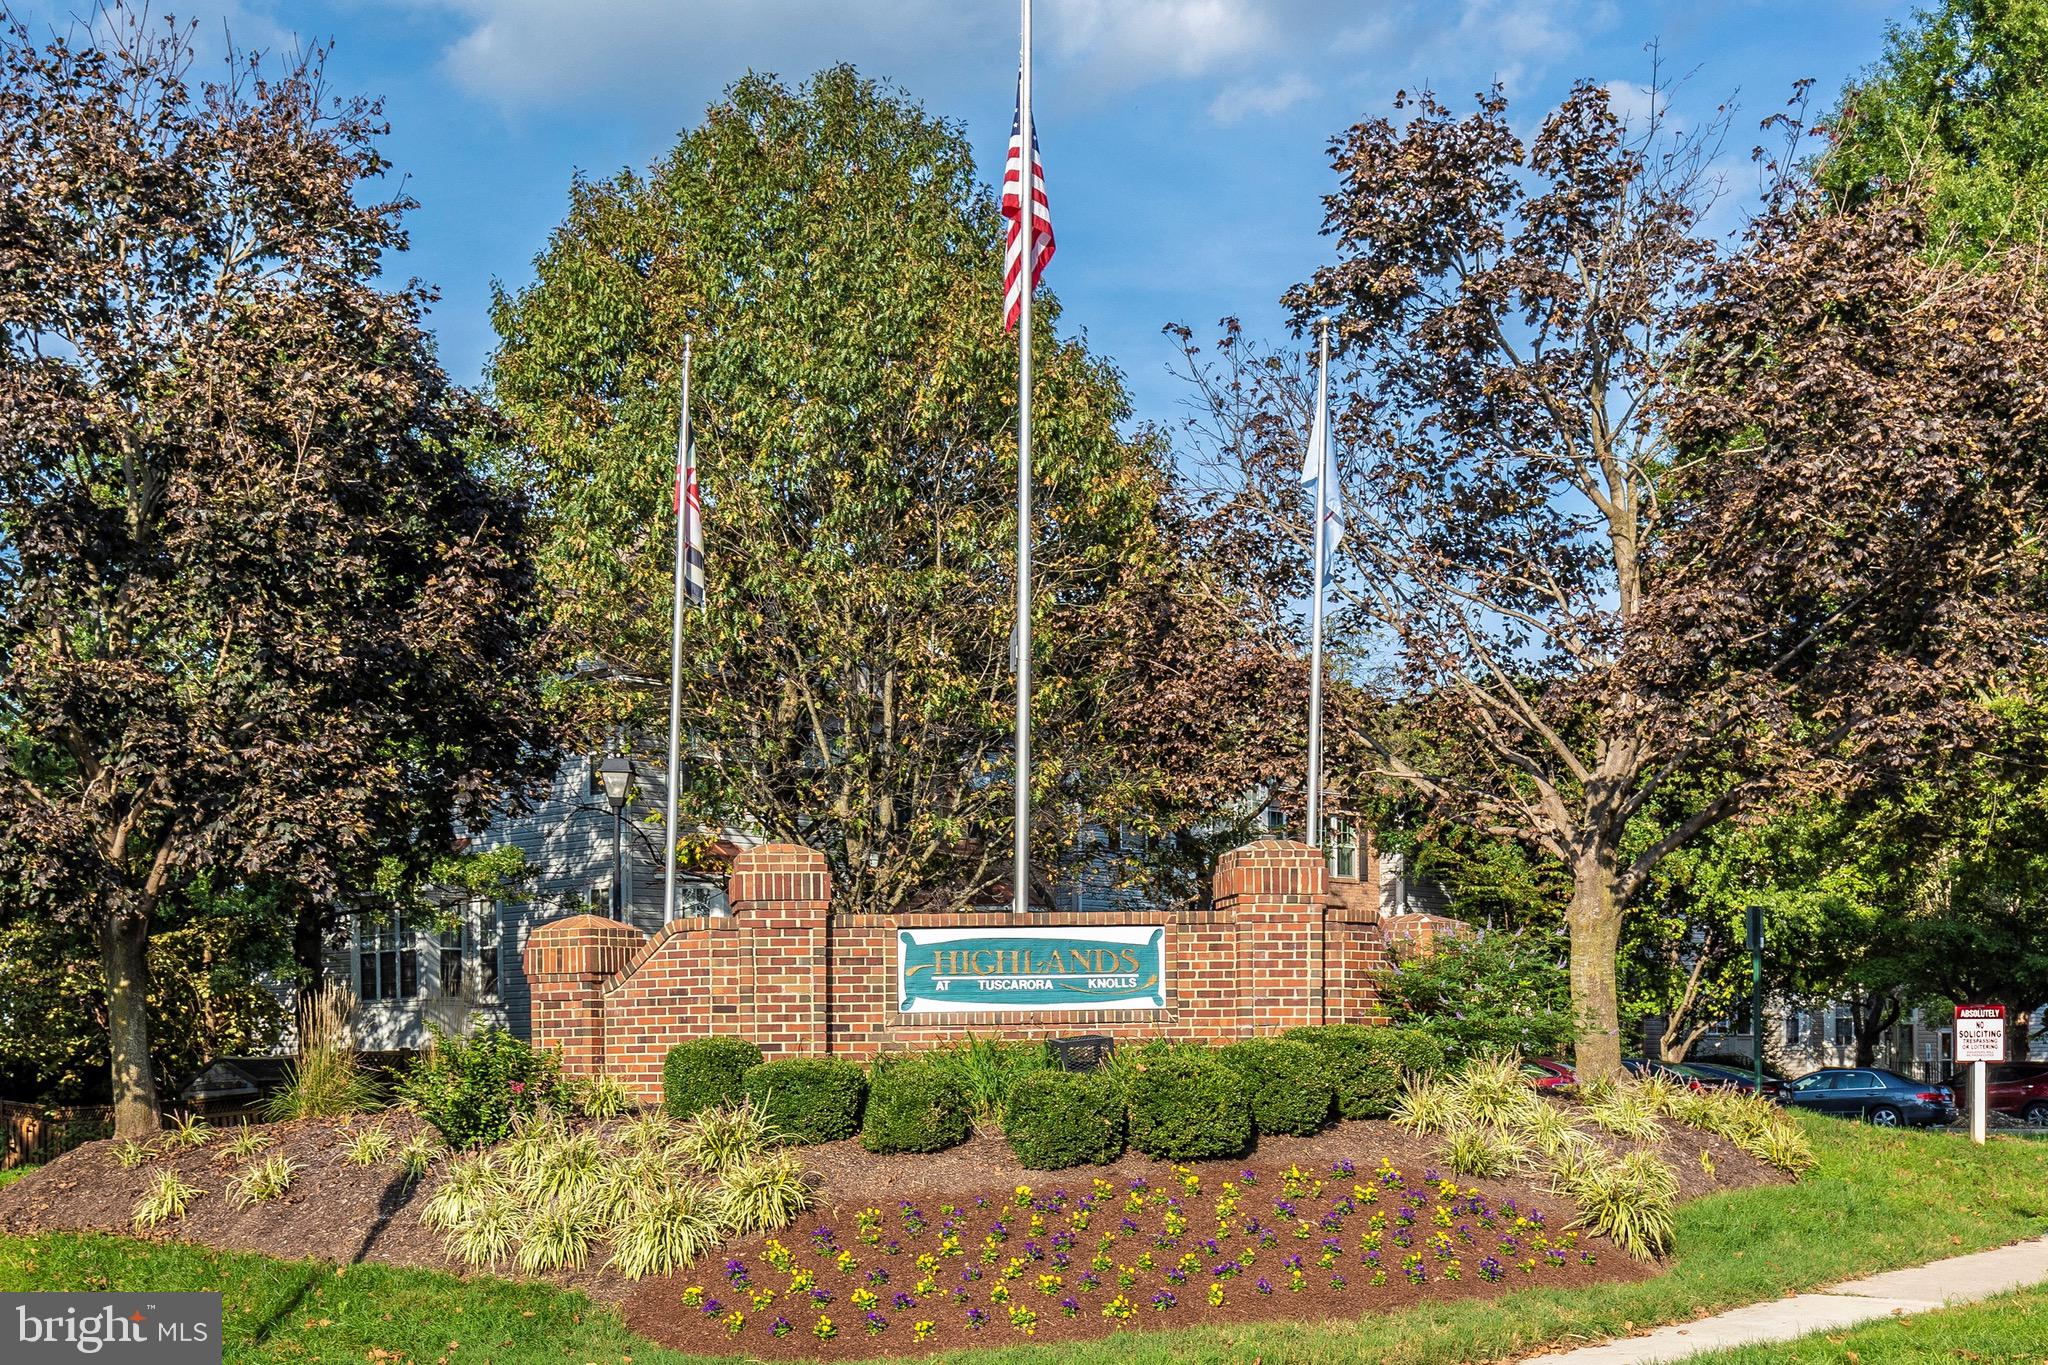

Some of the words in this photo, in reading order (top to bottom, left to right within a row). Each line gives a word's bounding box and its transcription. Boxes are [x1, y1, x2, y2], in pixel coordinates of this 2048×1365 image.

[932, 948, 1141, 976] HIGHLANDS
[935, 979, 951, 991] AT
[978, 979, 1054, 991] TUSCARORA
[1088, 977, 1137, 989] KNOLLS
[1960, 1009, 2000, 1017] ABSOLUTELY
[1976, 1021, 1984, 1029] NO
[1959, 1030, 2002, 1038] SOLICITING
